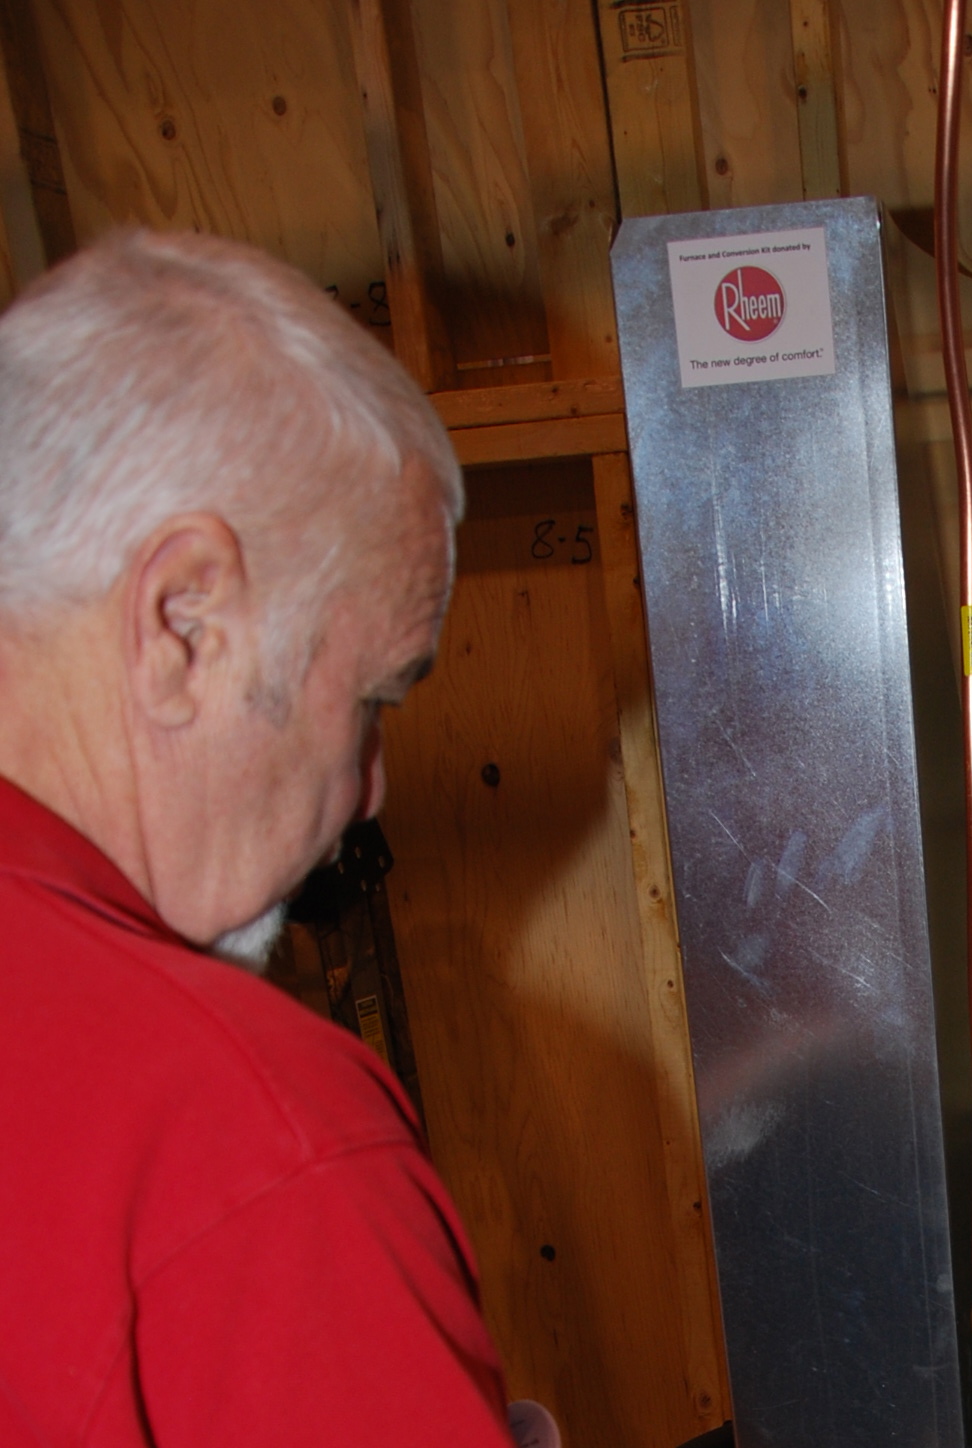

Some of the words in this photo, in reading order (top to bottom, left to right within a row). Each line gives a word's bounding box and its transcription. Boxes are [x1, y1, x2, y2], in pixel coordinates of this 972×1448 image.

[679, 252, 706, 262] Furnace
[708, 251, 720, 260] and
[721, 248, 760, 259] Conversion
[761, 246, 771, 254] Kit
[772, 244, 800, 254] donated
[802, 243, 811, 252] by
[720, 269, 783, 331] Rheem
[690, 359, 709, 370] The
[710, 357, 731, 368] new
[733, 353, 767, 367] degree
[769, 351, 780, 362] of
[531, 519, 593, 564] 8-5
